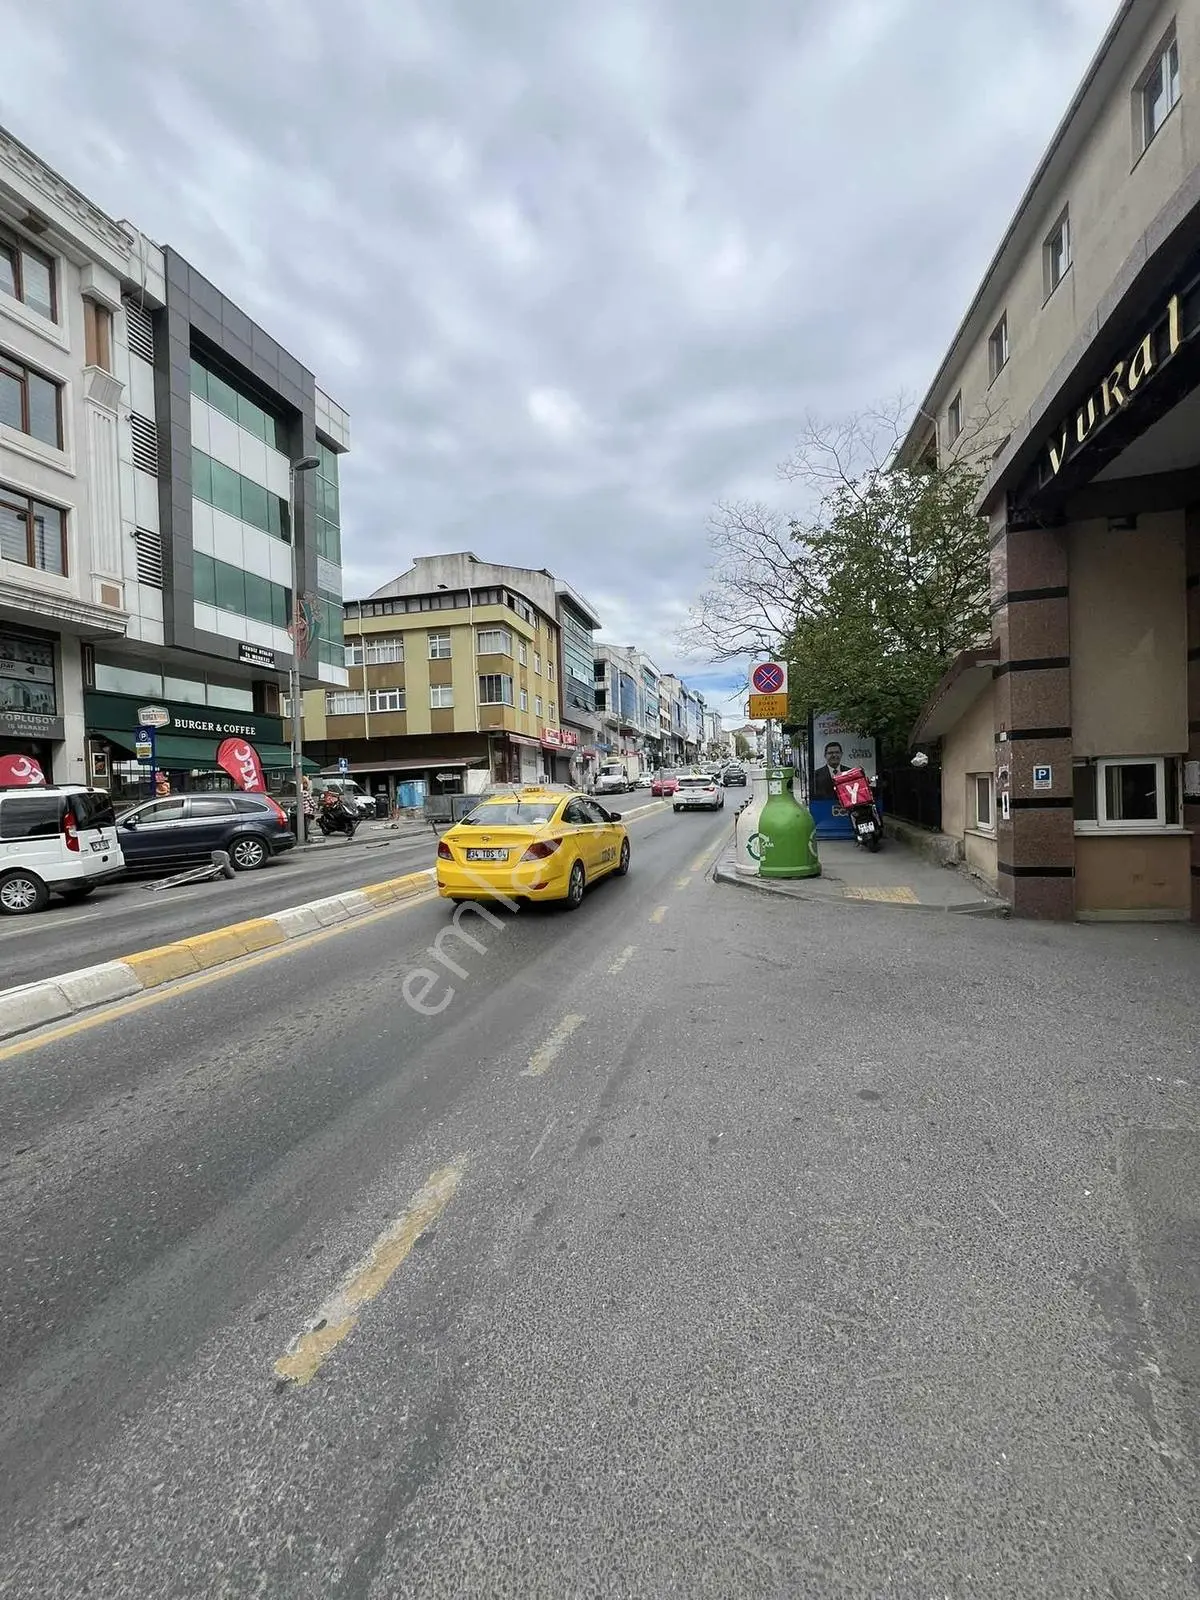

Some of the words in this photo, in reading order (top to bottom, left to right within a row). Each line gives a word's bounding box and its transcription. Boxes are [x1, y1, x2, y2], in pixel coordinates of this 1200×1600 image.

[174, 718, 215, 732] BURGER
[215, 723, 222, 732] &
[223, 724, 256, 736] COFFEE
[234, 745, 259, 791] KFC
[1038, 769, 1047, 780] P
[471, 850, 479, 858] 34
